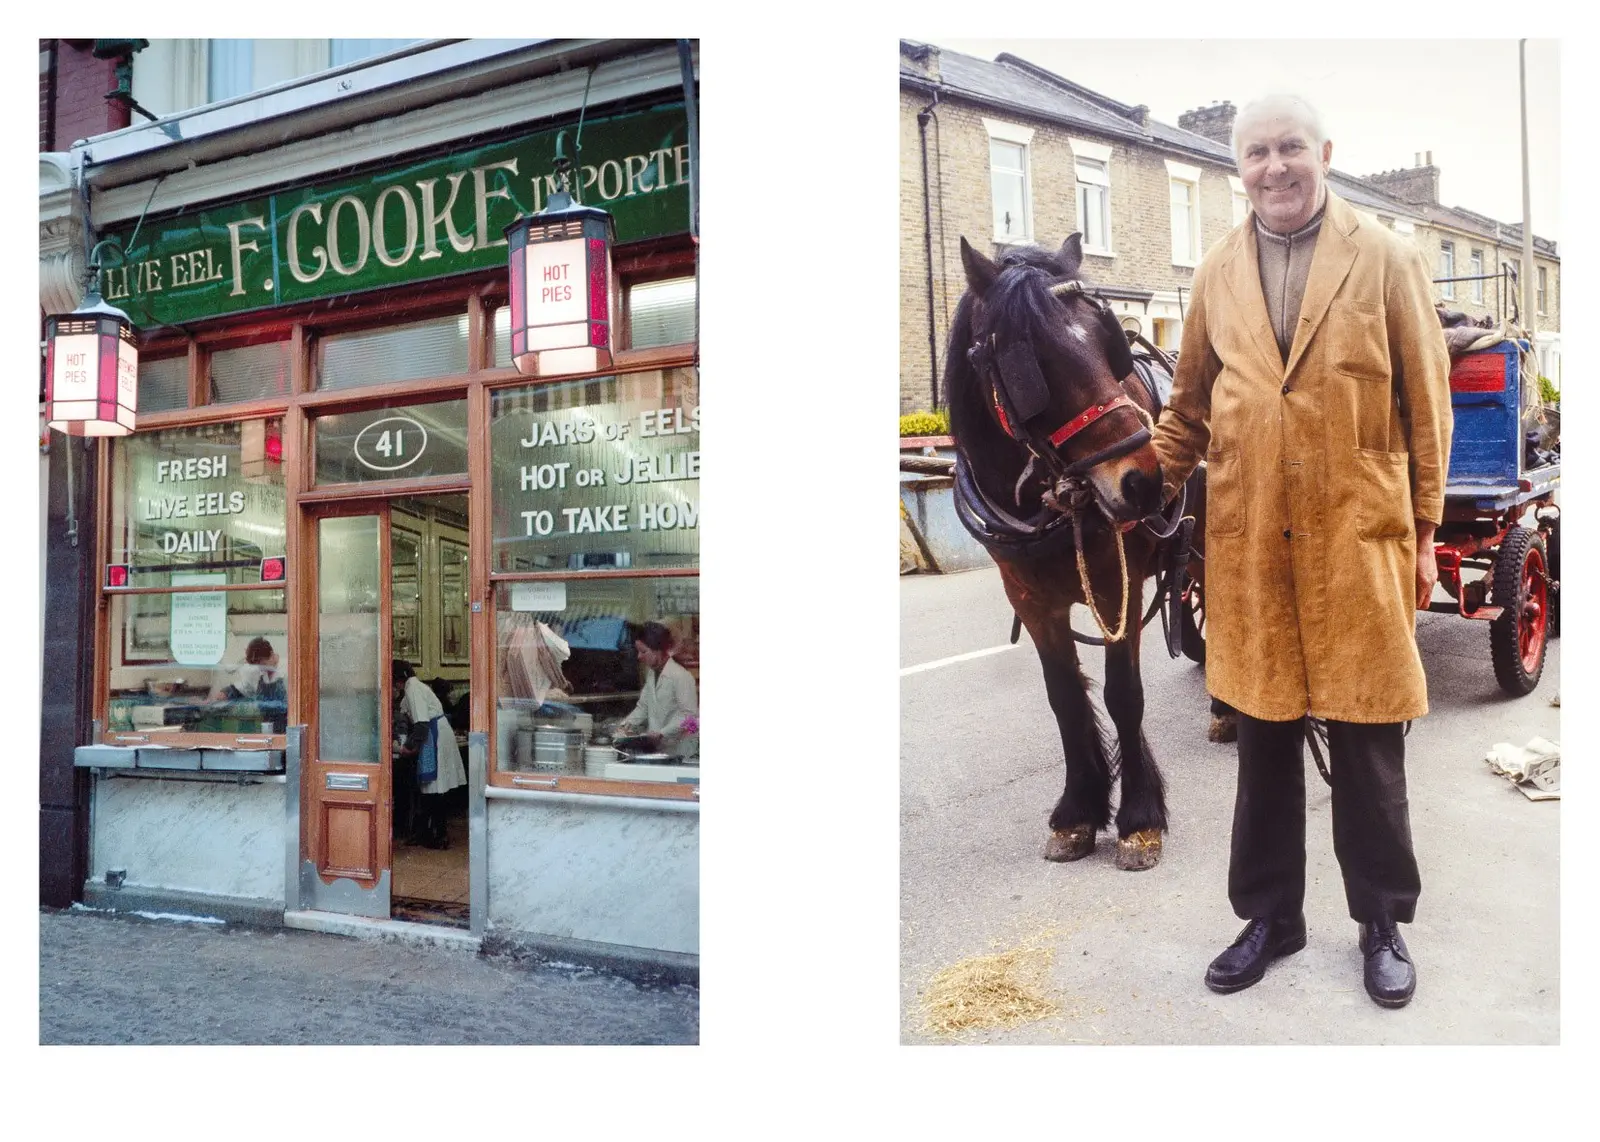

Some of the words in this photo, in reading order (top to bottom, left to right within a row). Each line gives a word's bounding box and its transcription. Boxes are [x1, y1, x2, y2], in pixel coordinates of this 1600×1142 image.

[106, 259, 162, 300] LIVE
[171, 248, 223, 287] EEL
[226, 216, 274, 297] F.
[286, 157, 519, 283] COOKE
[543, 264, 570, 282] HOT
[542, 286, 572, 303] PIES
[66, 353, 87, 366] HOT
[65, 371, 87, 383] PIES
[521, 419, 595, 449] JARS
[602, 422, 631, 441] OF
[640, 406, 699, 438] EELS
[375, 428, 403, 458] 41
[157, 454, 228, 484] FRESH
[521, 462, 571, 492] HOT
[575, 468, 606, 487] OR
[614, 450, 699, 484] JELLIE
[145, 496, 189, 520] LIVE
[195, 490, 245, 517] EELS
[521, 509, 555, 537] TO
[562, 504, 630, 535] TAKE
[164, 528, 223, 555] DAILY
